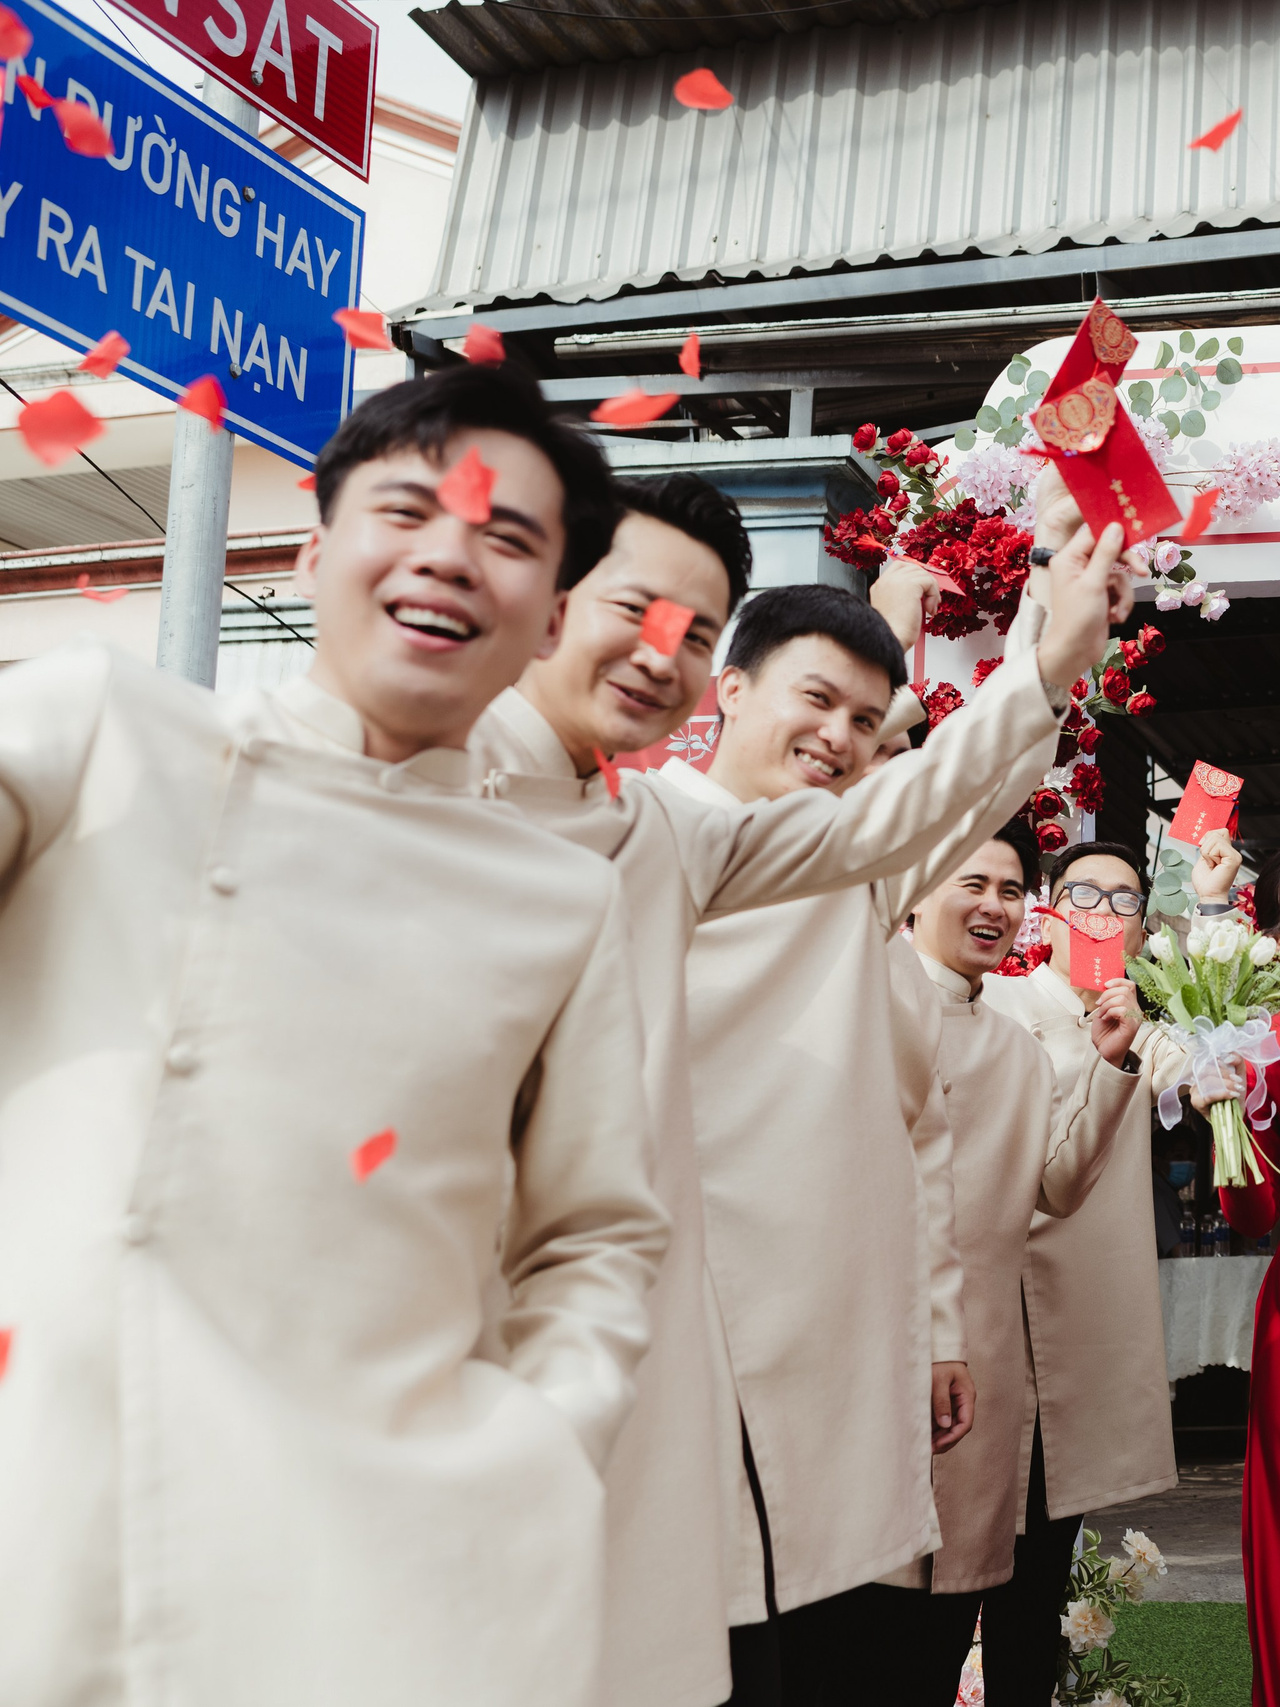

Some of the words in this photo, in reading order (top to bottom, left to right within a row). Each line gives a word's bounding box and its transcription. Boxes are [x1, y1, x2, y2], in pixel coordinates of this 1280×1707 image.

[37, 198, 108, 294] RA
[125, 246, 196, 340] TAI
[210, 297, 308, 402] NẠN
[256, 202, 341, 297] HAY
